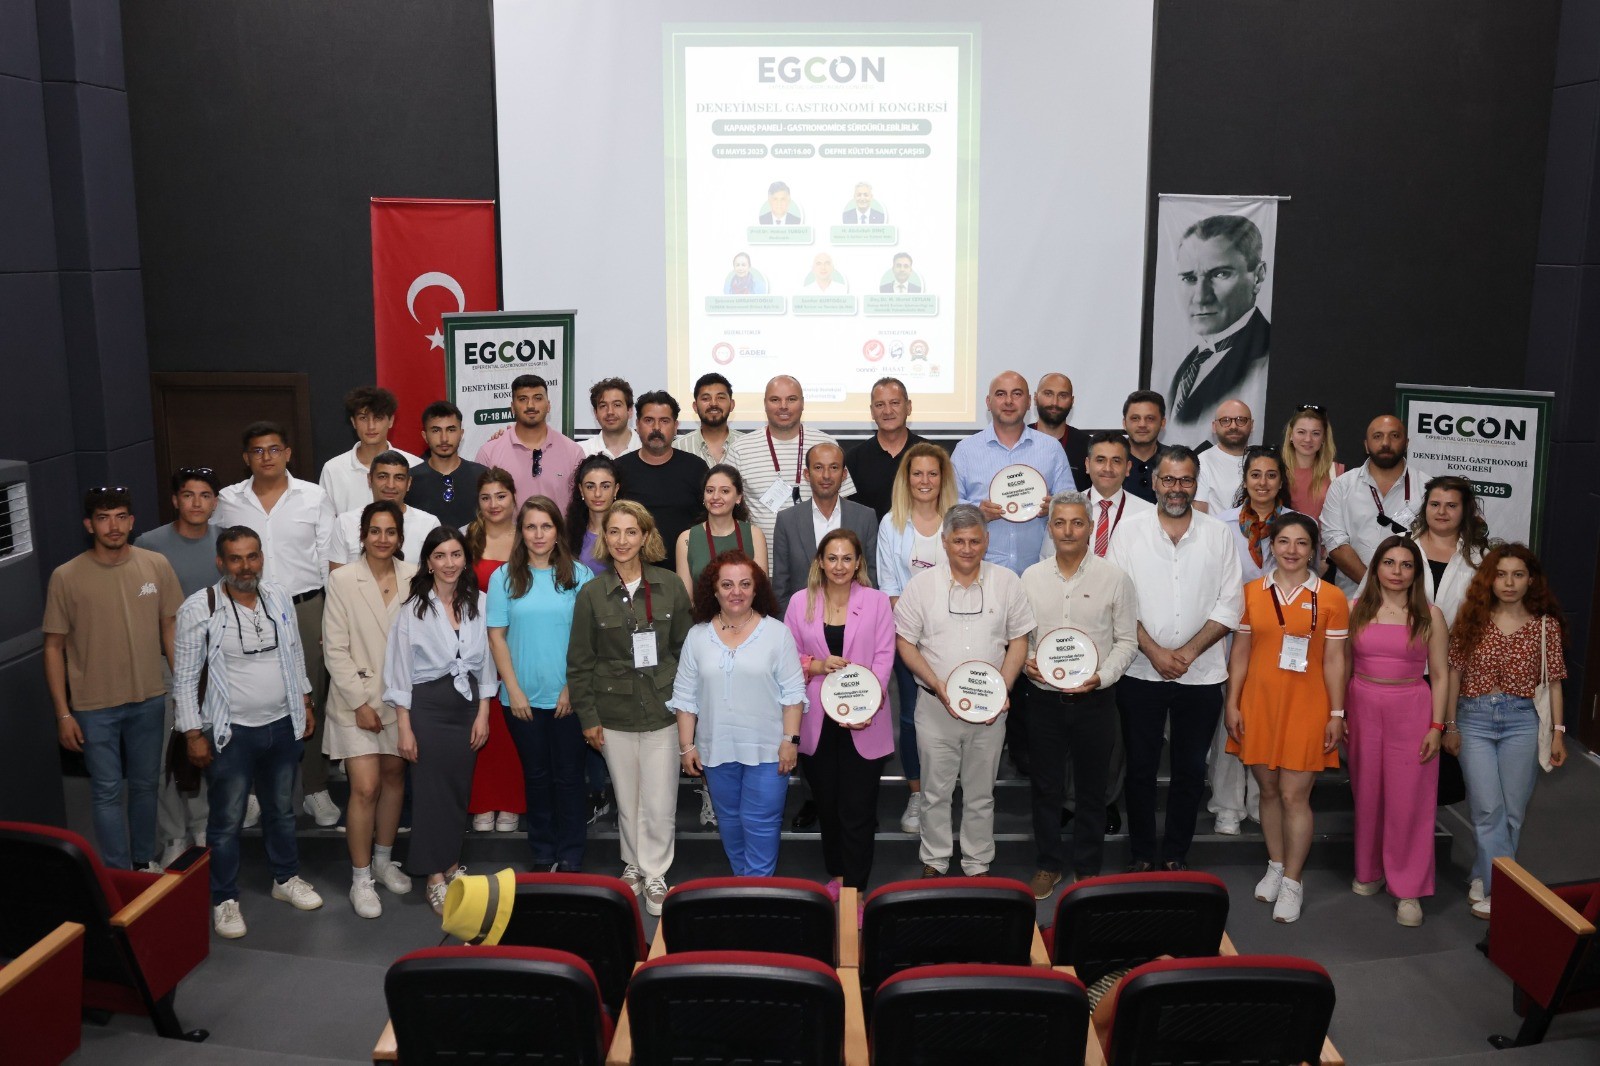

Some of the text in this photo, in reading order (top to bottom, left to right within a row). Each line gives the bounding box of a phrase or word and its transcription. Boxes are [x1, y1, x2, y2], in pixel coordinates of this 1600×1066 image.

[758, 56, 885, 83] EGCON
[696, 101, 948, 113] DENEYİMSEL GASTRONOMİ KONGRESİ
[724, 124, 756, 133] KAPANIŞ
[757, 123, 783, 132] PANELİ
[464, 339, 555, 365] EGCON
[461, 382, 510, 392] DENEYİMSEL
[479, 411, 500, 422] 17-18
[1417, 412, 1527, 441] EGCON
[1413, 452, 1528, 468] DENEYİMSEL GASTRONOMİ
[1447, 463, 1492, 473] KONGRESİ
[1483, 485, 1505, 495] 2025
[968, 677, 987, 685] EGCON
